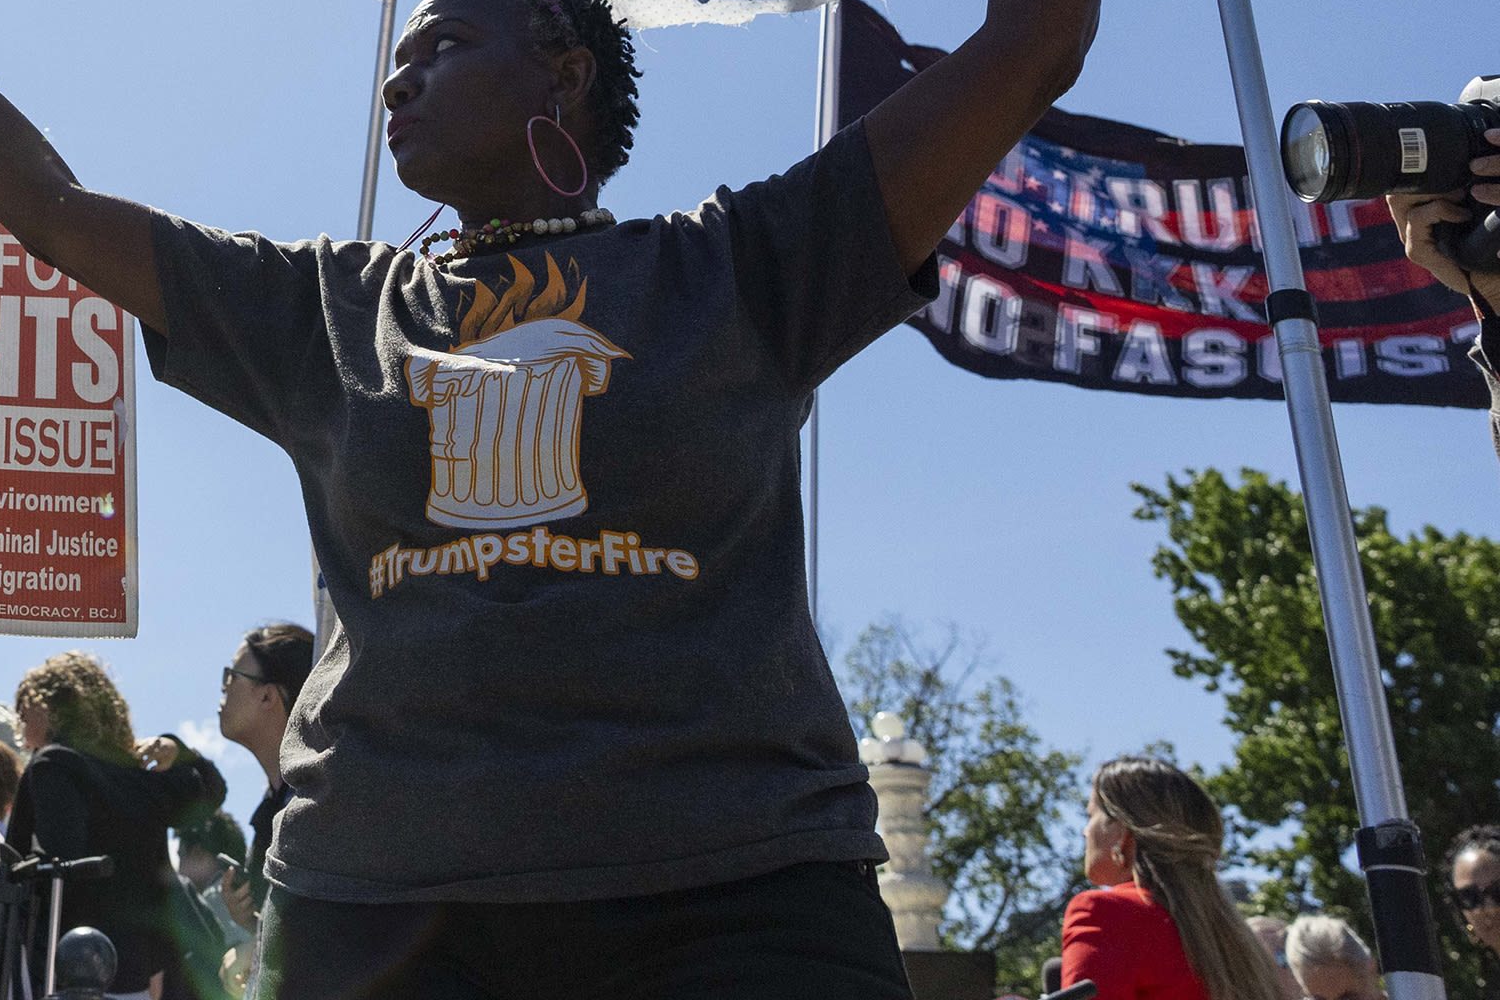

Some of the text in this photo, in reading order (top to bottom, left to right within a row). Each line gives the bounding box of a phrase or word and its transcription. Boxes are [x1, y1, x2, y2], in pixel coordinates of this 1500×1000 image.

[1062, 225, 1271, 325] KKK
[3, 415, 114, 471] ISSUE
[46, 529, 119, 558] Justice
[369, 526, 700, 599] #TrumpsterFire
